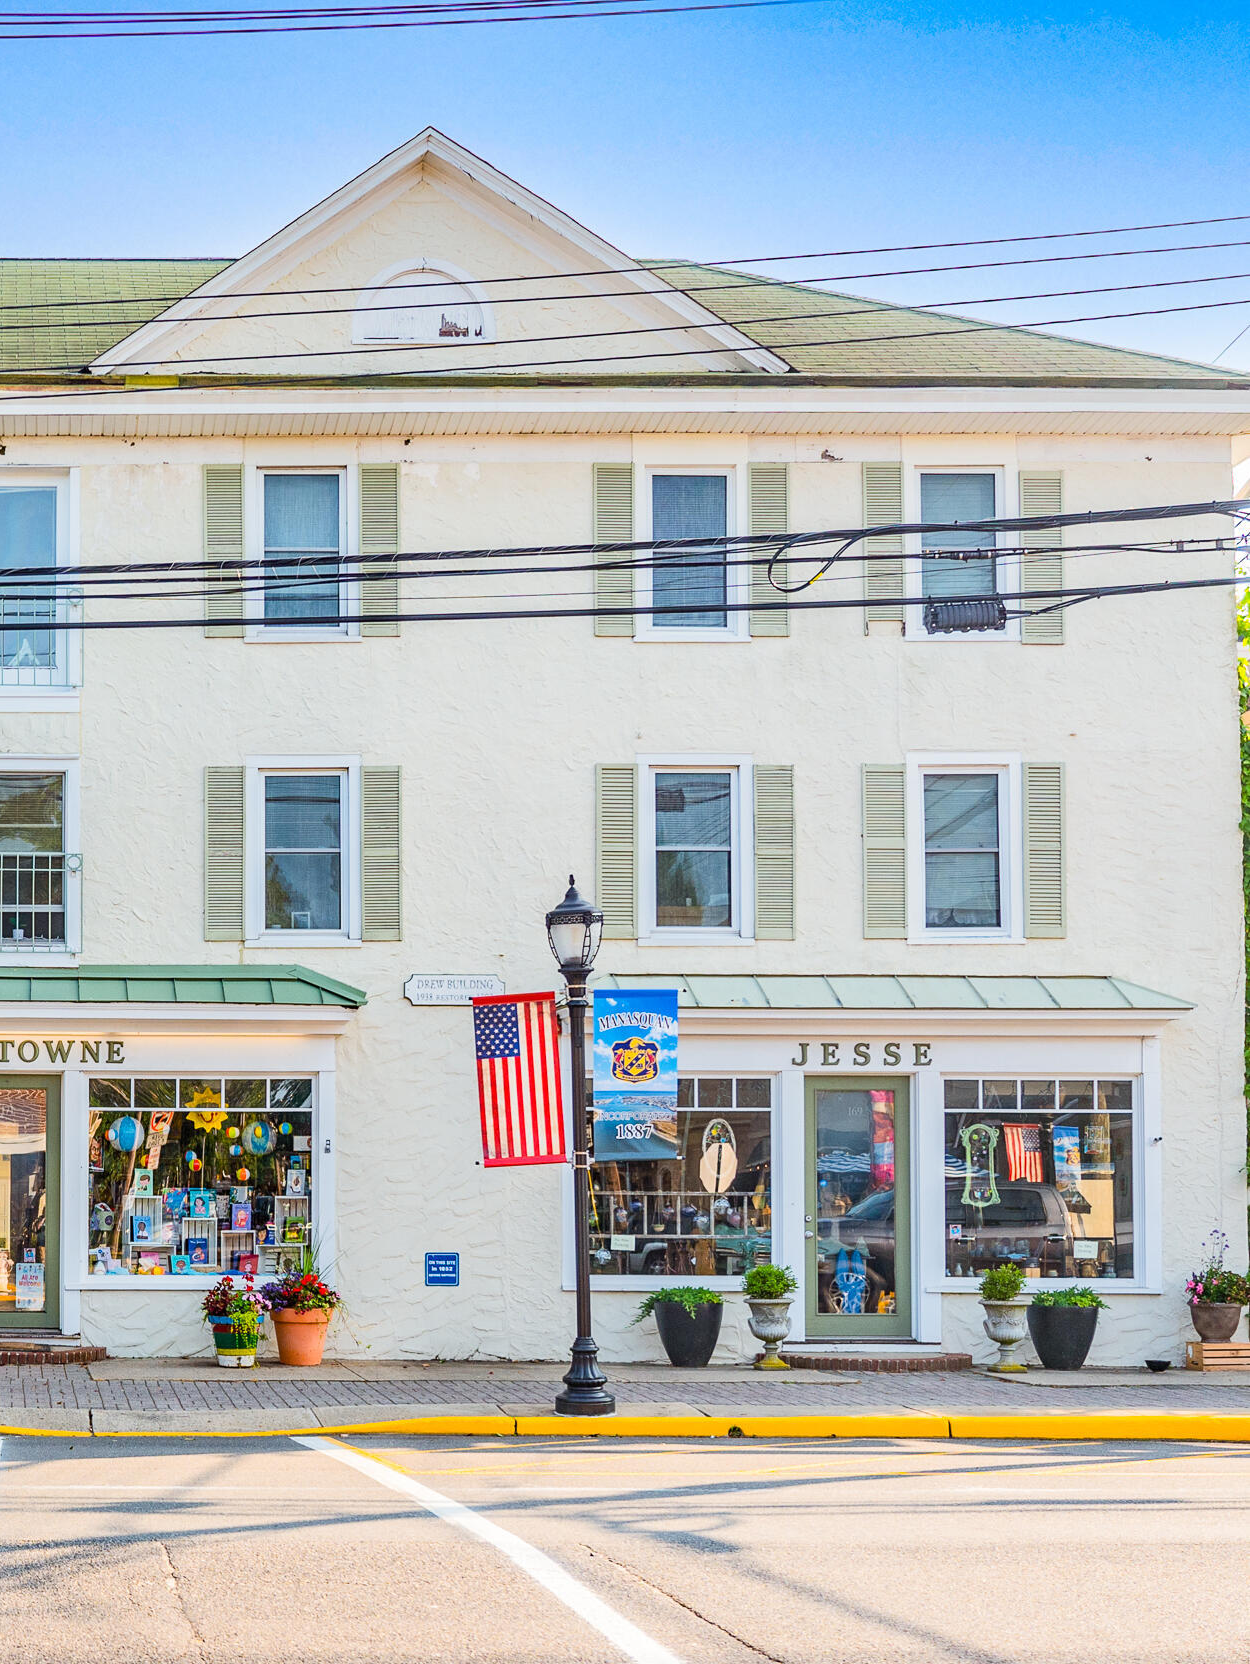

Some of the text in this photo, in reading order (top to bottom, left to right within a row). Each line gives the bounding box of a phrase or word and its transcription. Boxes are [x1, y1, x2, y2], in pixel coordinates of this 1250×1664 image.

[416, 979, 494, 990] DREW BUILDING
[598, 1011, 674, 1032] MANASQUAN
[791, 1042, 933, 1067] JESSE
[598, 1111, 673, 1121] INCORPORATED
[616, 1123, 654, 1140] 1887
